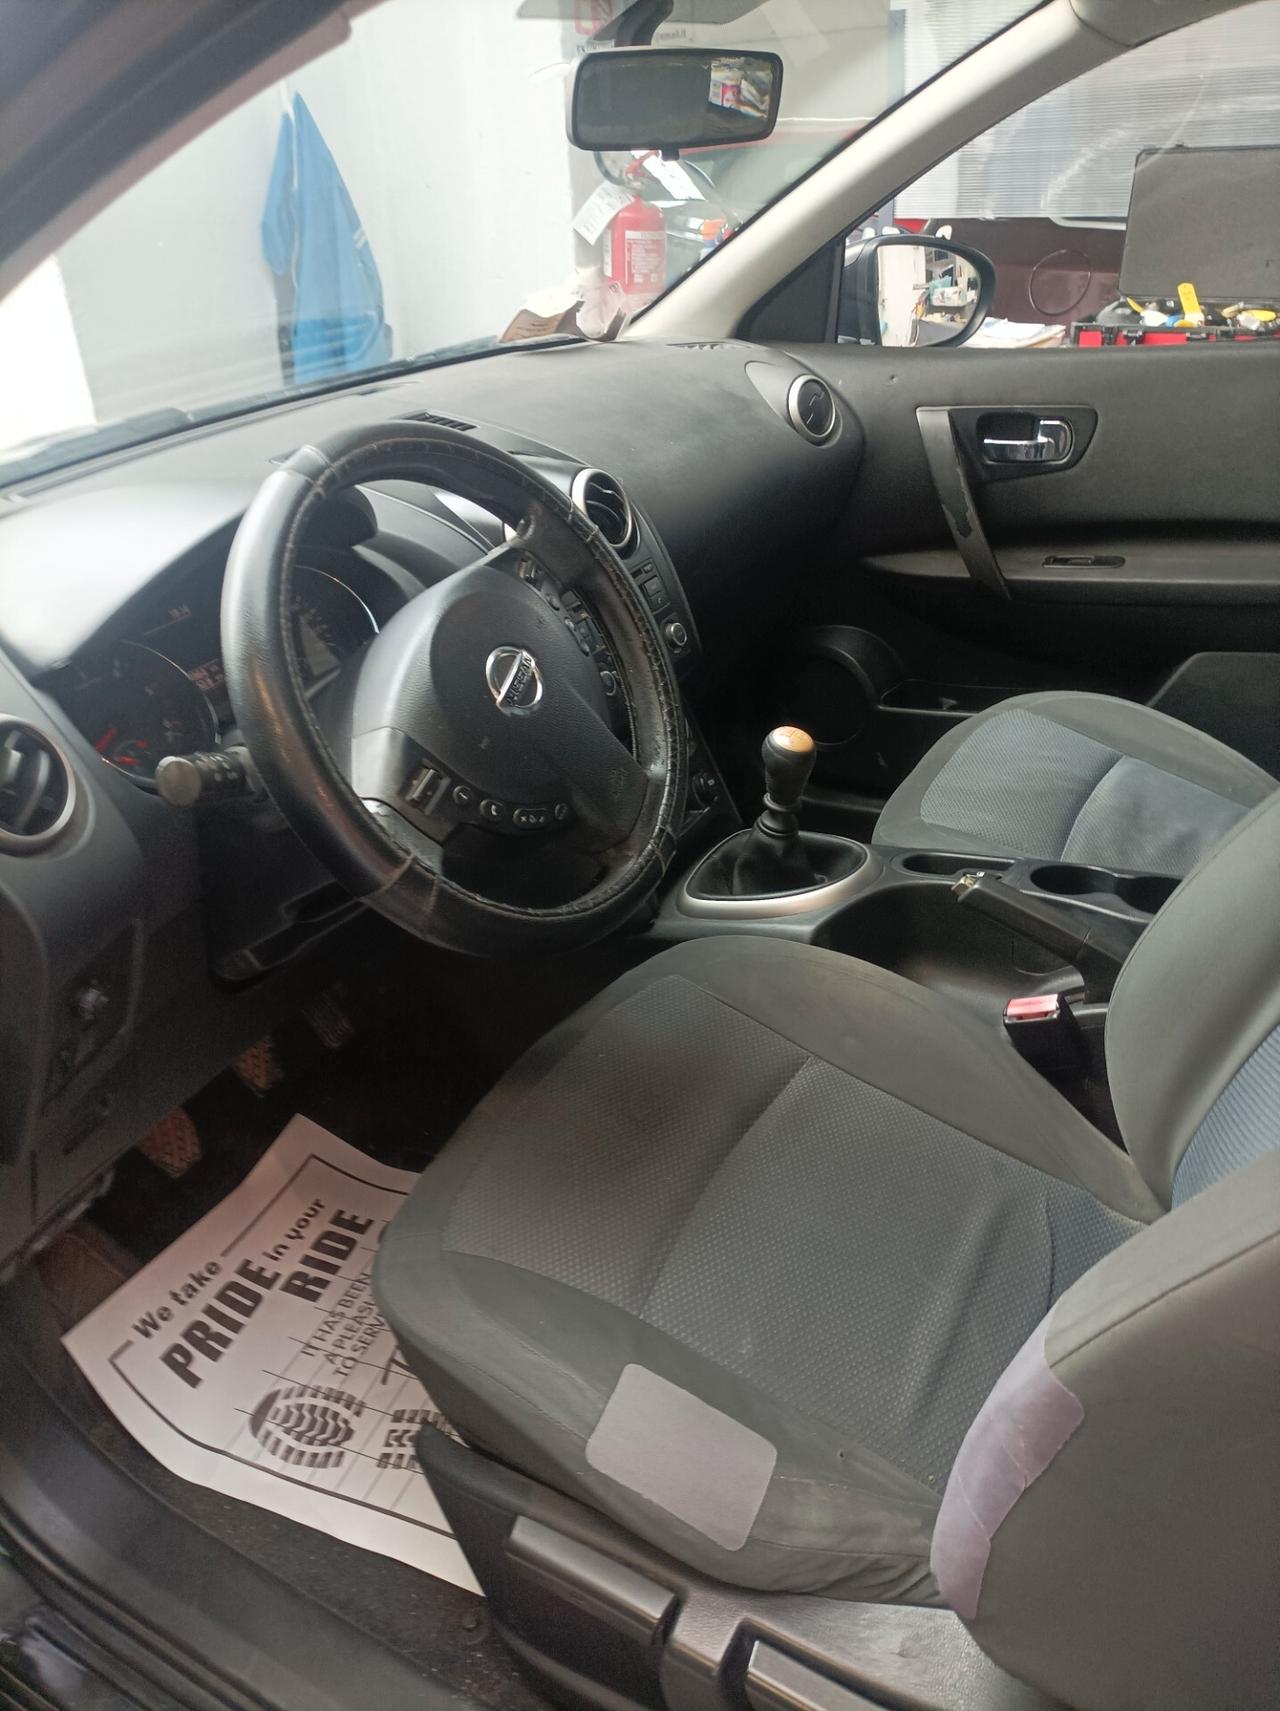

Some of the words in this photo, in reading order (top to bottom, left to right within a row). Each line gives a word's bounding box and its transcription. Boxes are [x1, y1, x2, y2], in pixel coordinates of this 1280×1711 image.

[159, 1258, 282, 1389] PRIDE
[285, 1198, 326, 1240] your
[279, 1209, 374, 1303] RIDE
[131, 1311, 174, 1339] We
[168, 1260, 223, 1306] take
[300, 1342, 321, 1358] IT
[312, 1309, 346, 1342] HAS
[338, 1272, 372, 1309] BEEN
[324, 1352, 341, 1365] A
[332, 1356, 356, 1377] TO
[351, 1313, 385, 1356] SERV
